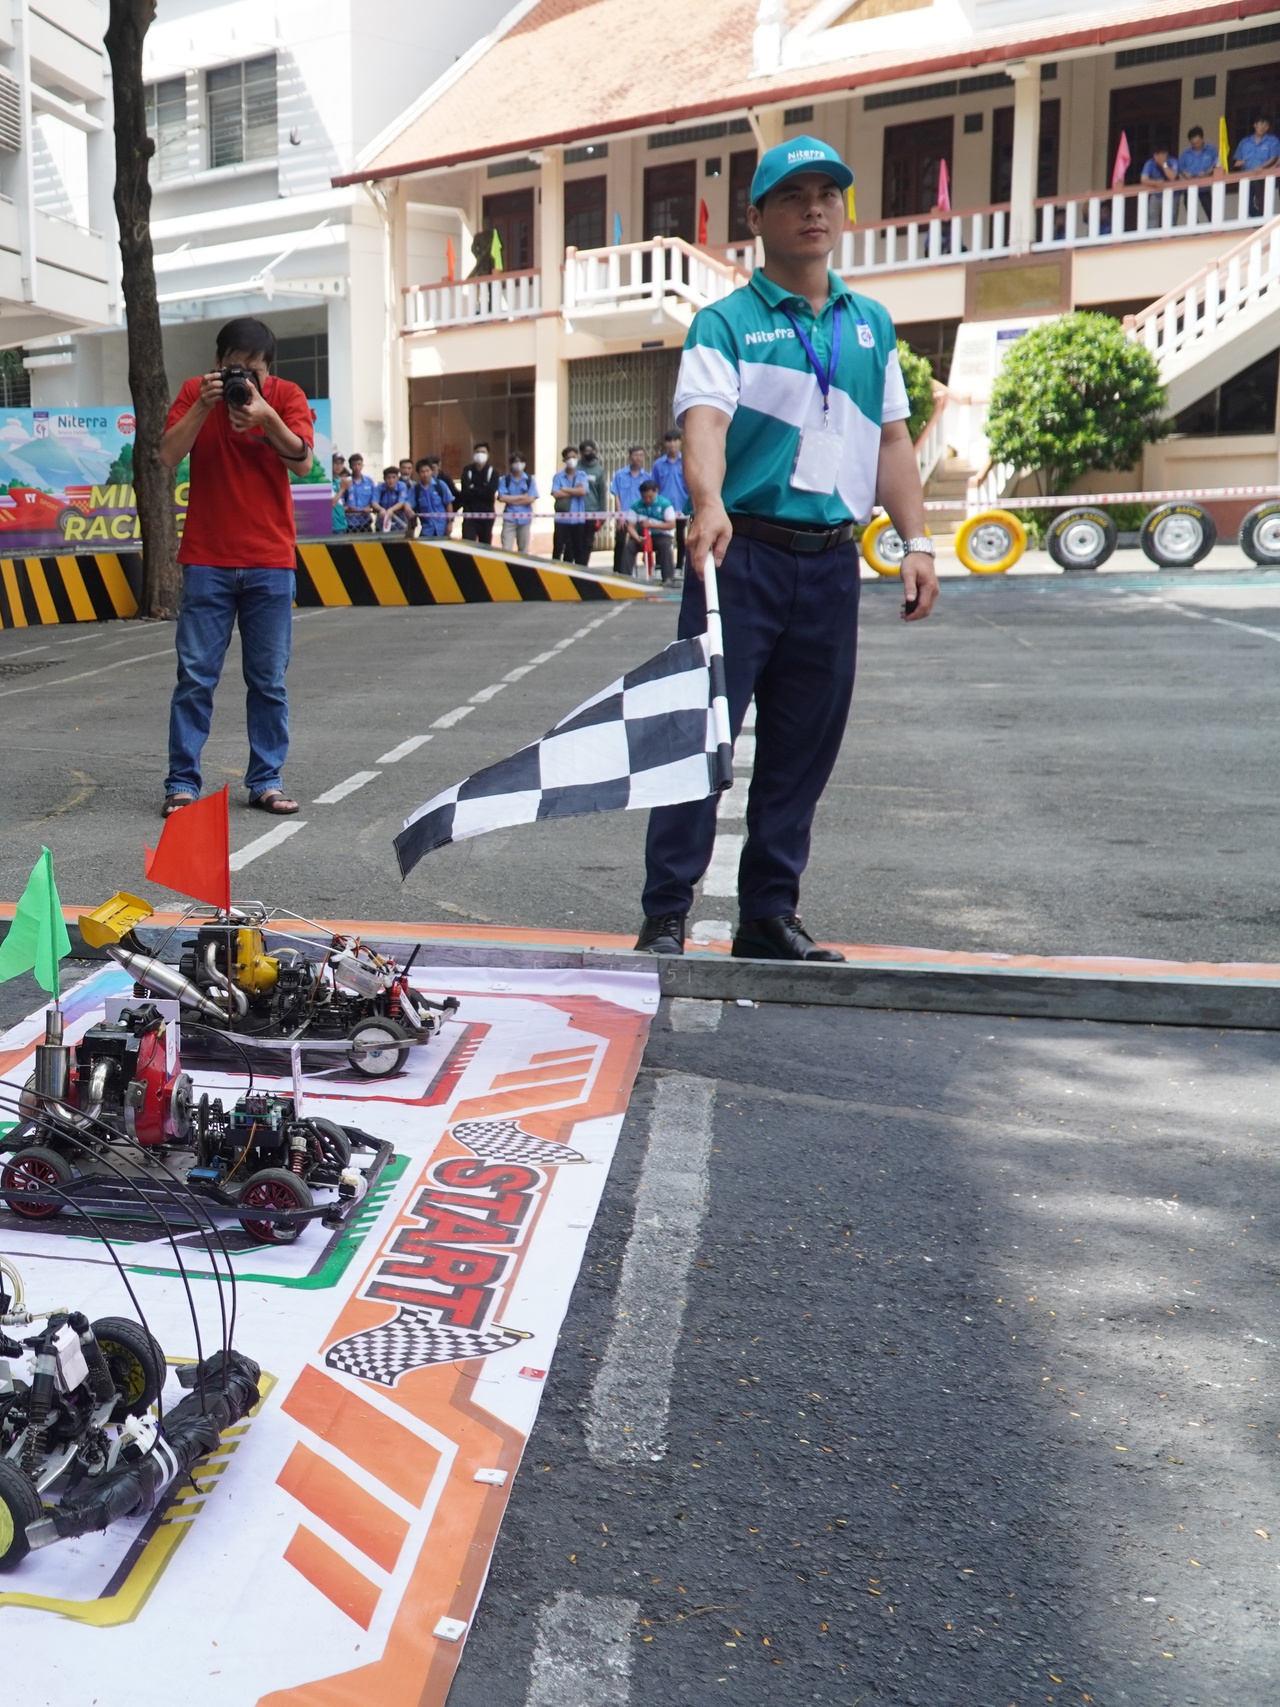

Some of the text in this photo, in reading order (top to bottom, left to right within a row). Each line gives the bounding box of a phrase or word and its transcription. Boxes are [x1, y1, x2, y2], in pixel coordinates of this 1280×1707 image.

[787, 149, 825, 161] Niterra
[745, 327, 796, 346] Niterra
[58, 415, 108, 428] Niterra
[364, 1159, 541, 1332] START
